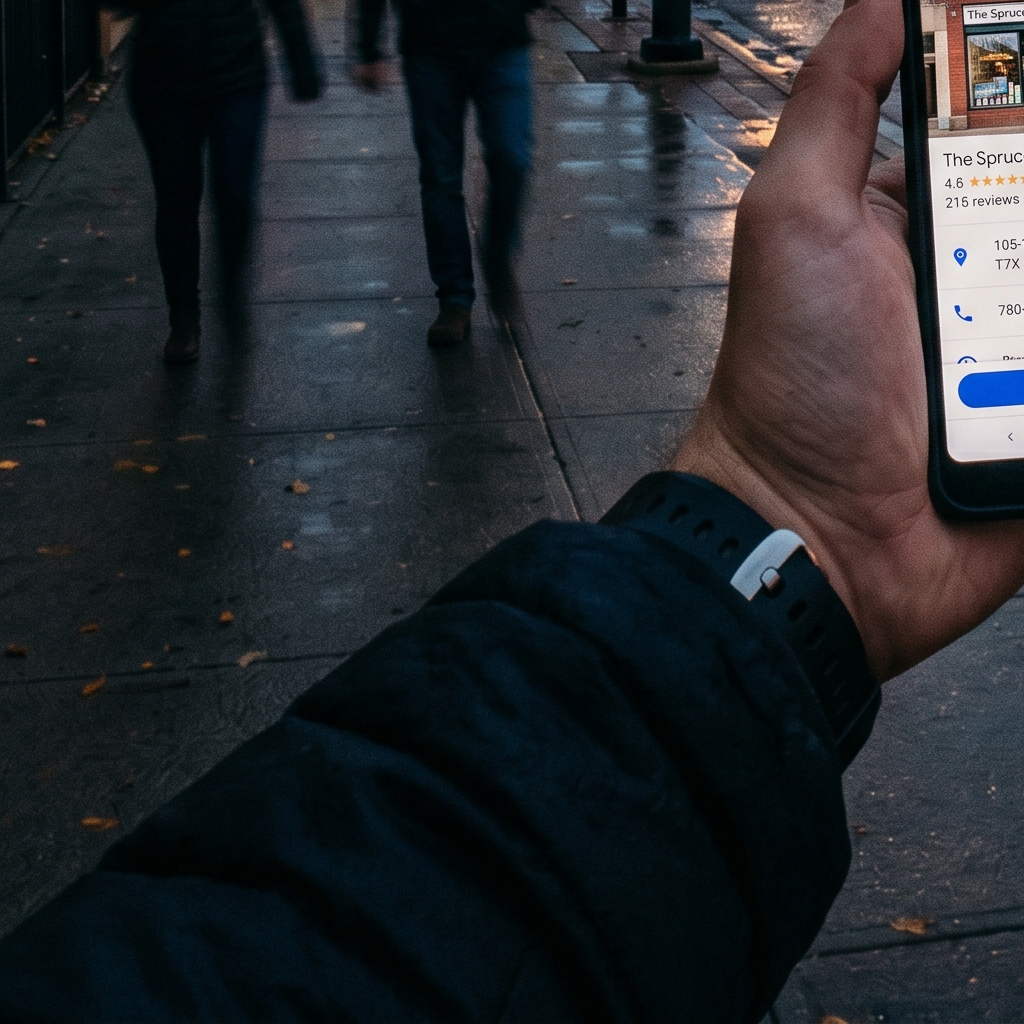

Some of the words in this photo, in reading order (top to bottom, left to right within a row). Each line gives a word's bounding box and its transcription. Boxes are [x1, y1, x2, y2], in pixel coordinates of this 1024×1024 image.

[967, 10, 988, 20] The
[943, 152, 973, 167] The
[944, 178, 964, 189] 4.6
[972, 192, 1020, 207] reviews
[995, 258, 1021, 270] T7X
